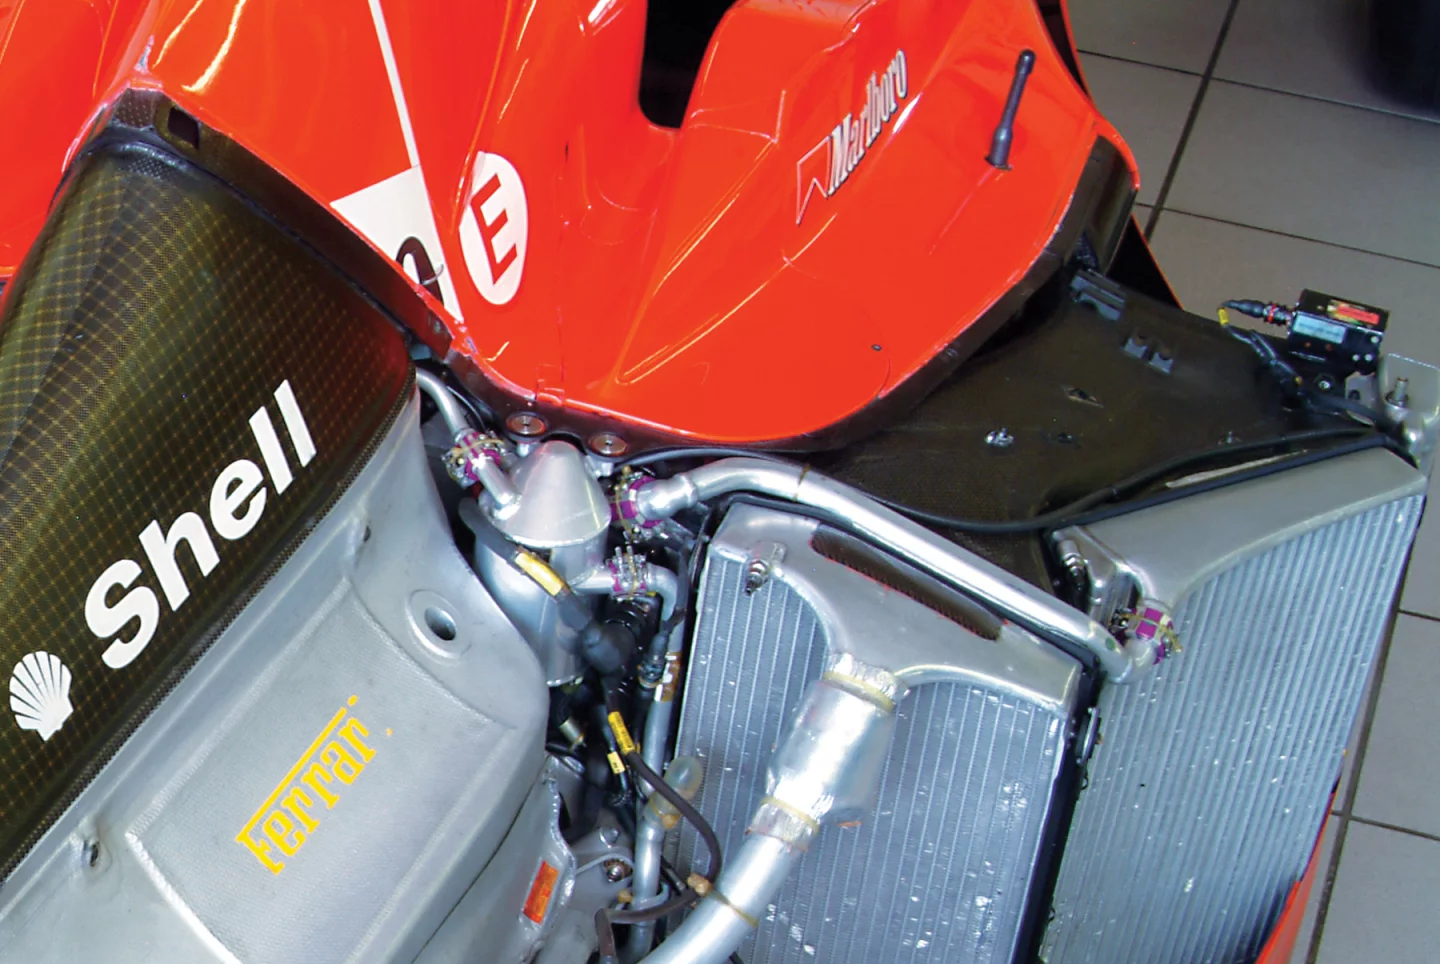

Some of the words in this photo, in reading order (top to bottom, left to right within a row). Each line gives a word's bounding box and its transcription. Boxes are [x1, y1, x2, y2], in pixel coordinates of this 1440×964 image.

[828, 49, 907, 196] Marlboro
[470, 172, 518, 286] E
[84, 378, 317, 669] Shell
[234, 694, 394, 877] Ferrar
